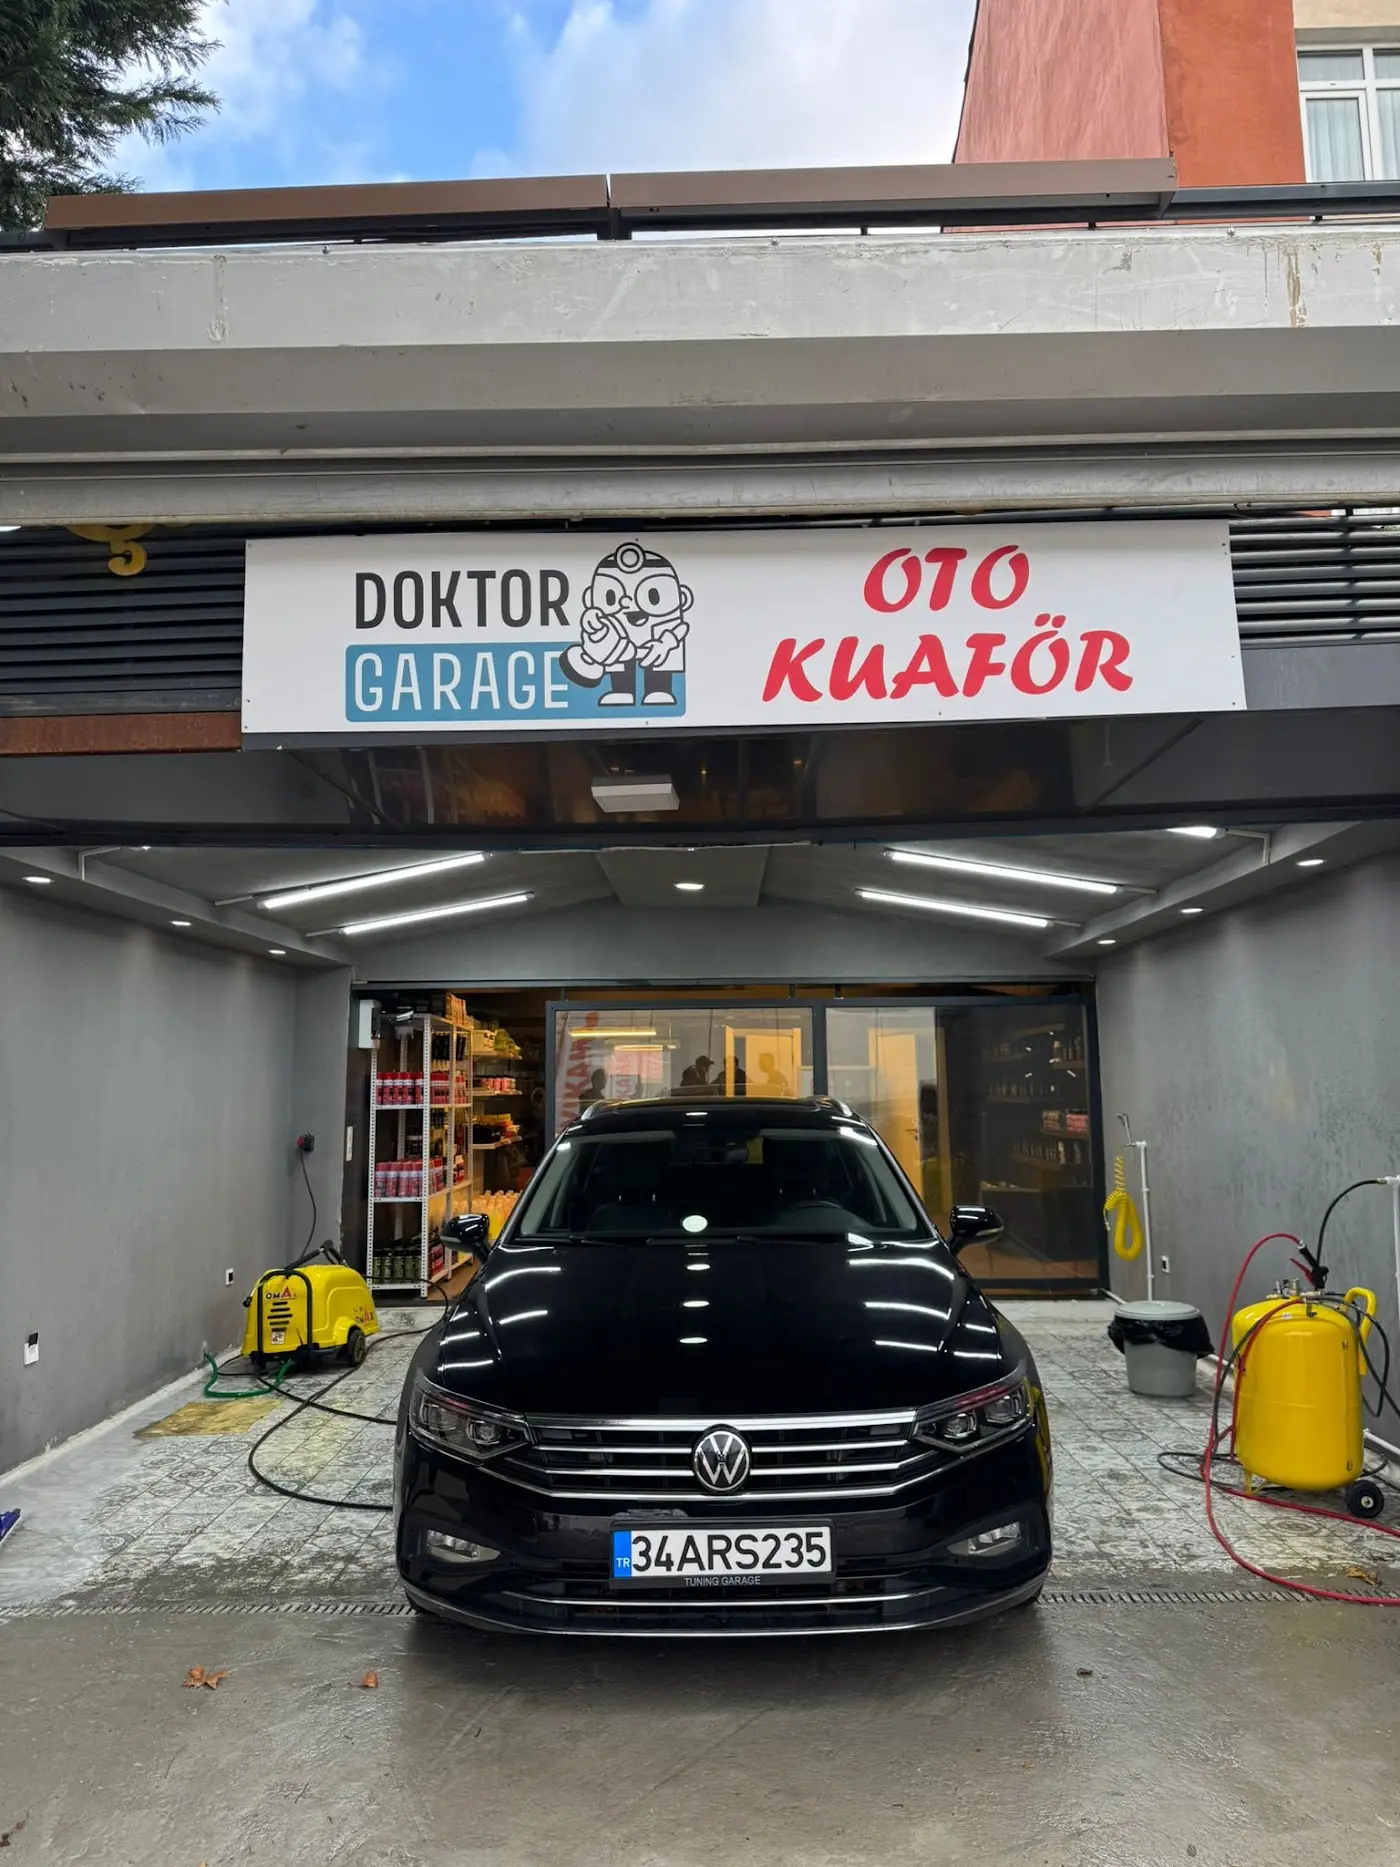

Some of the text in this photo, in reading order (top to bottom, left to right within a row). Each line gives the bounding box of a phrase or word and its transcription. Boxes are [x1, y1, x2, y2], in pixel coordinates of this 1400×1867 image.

[355, 568, 571, 629] DOKTOR
[863, 544, 1030, 613] OTO
[354, 650, 569, 712] GARAGE
[762, 612, 1134, 702] KUAFÖR
[265, 1286, 297, 1300] OMA
[616, 1557, 631, 1568] TR
[631, 1532, 827, 1573] 34ARS235
[684, 1575, 762, 1587] TUNING GARAGE
